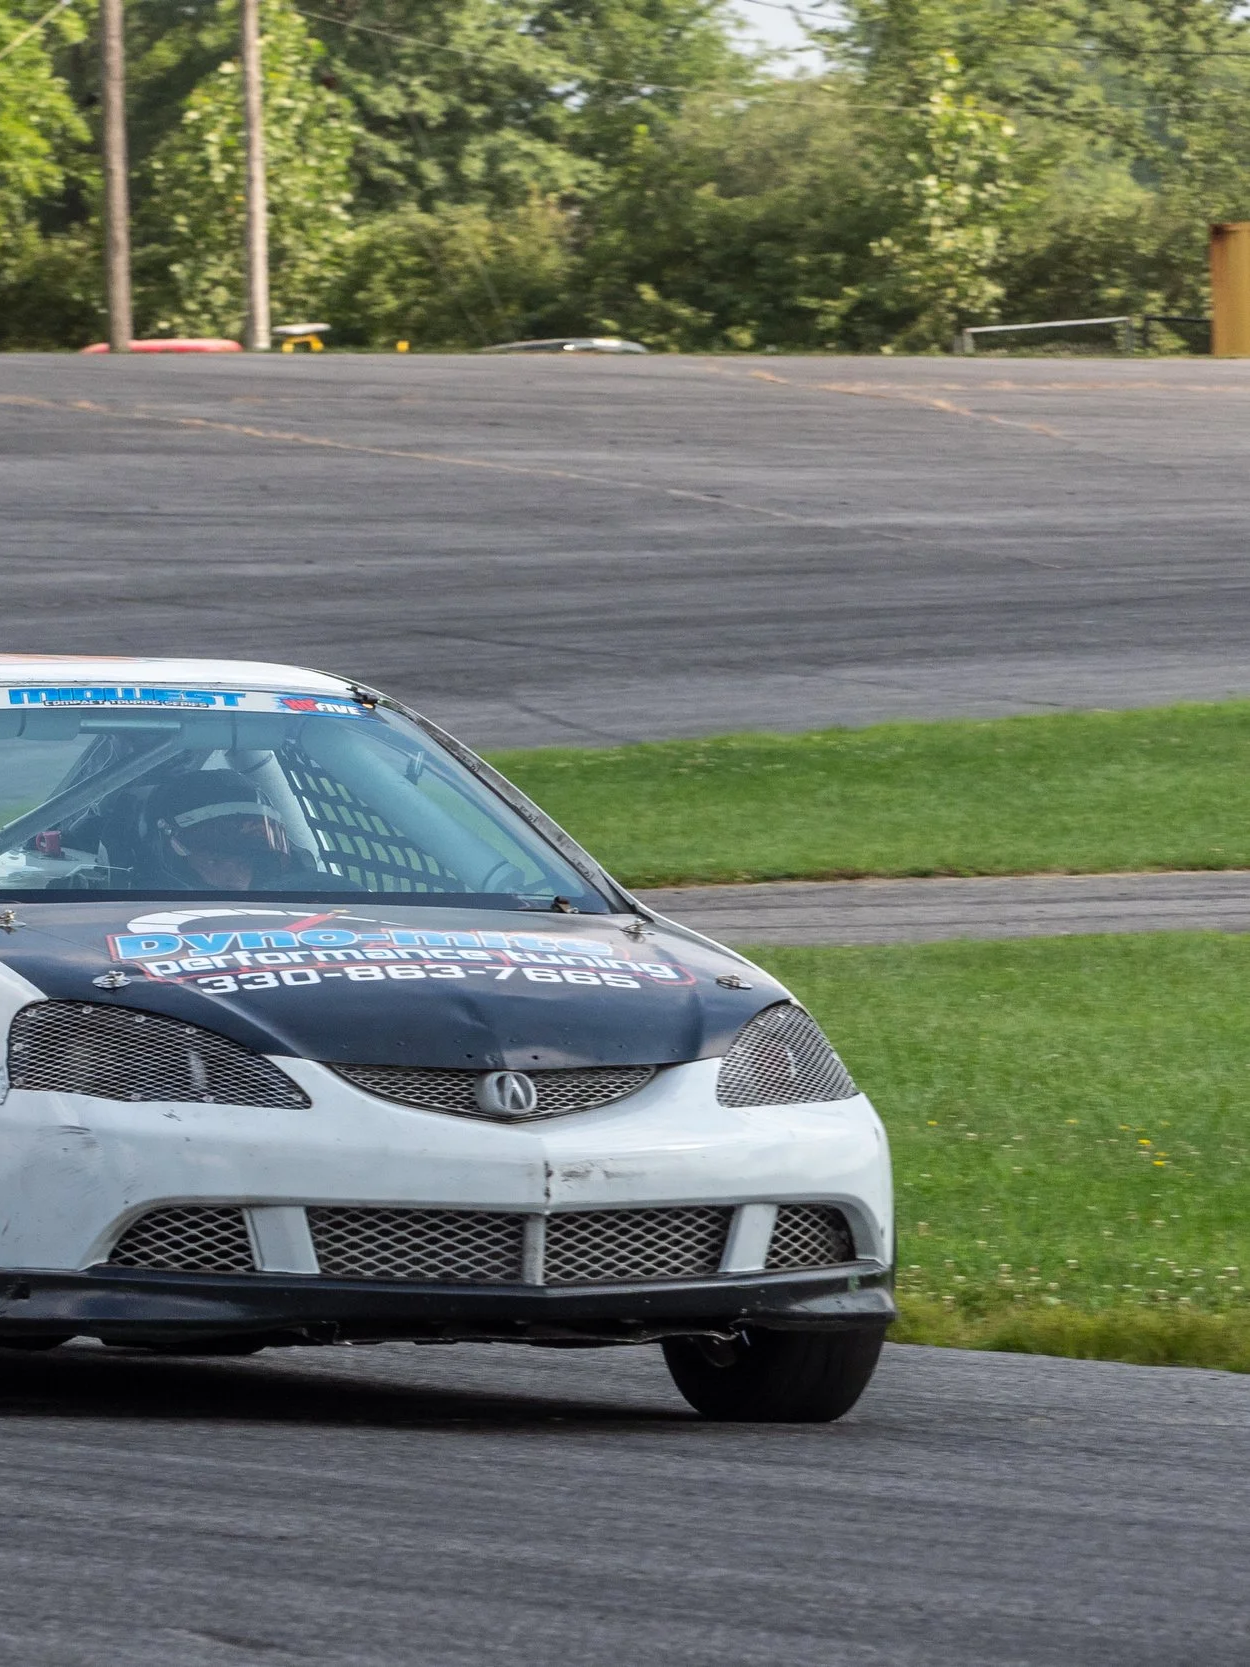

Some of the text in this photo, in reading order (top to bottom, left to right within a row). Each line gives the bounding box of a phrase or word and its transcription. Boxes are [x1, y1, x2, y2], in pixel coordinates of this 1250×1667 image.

[144, 947, 680, 980] performance tuning
[199, 964, 642, 995] 330-863-7665
